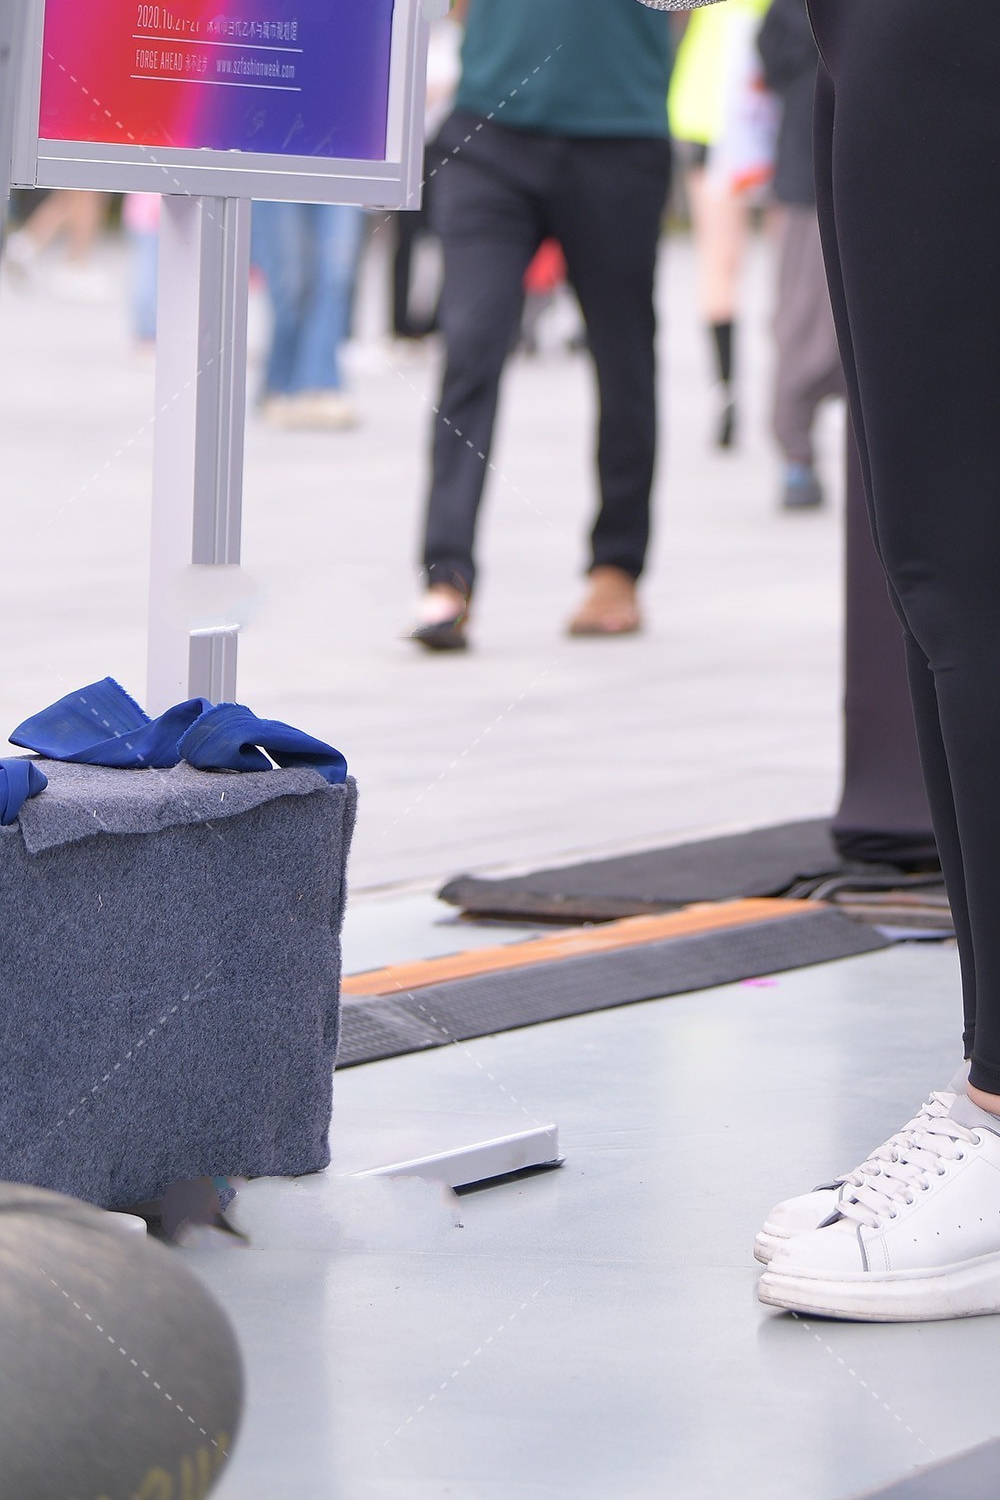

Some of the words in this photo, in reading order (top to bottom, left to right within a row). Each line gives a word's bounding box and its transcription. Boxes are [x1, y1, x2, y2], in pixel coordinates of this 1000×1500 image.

[135, 49, 158, 70] FORGE
[160, 51, 183, 72] AHEAD
[216, 56, 295, 79] www.szfashionweek.com
